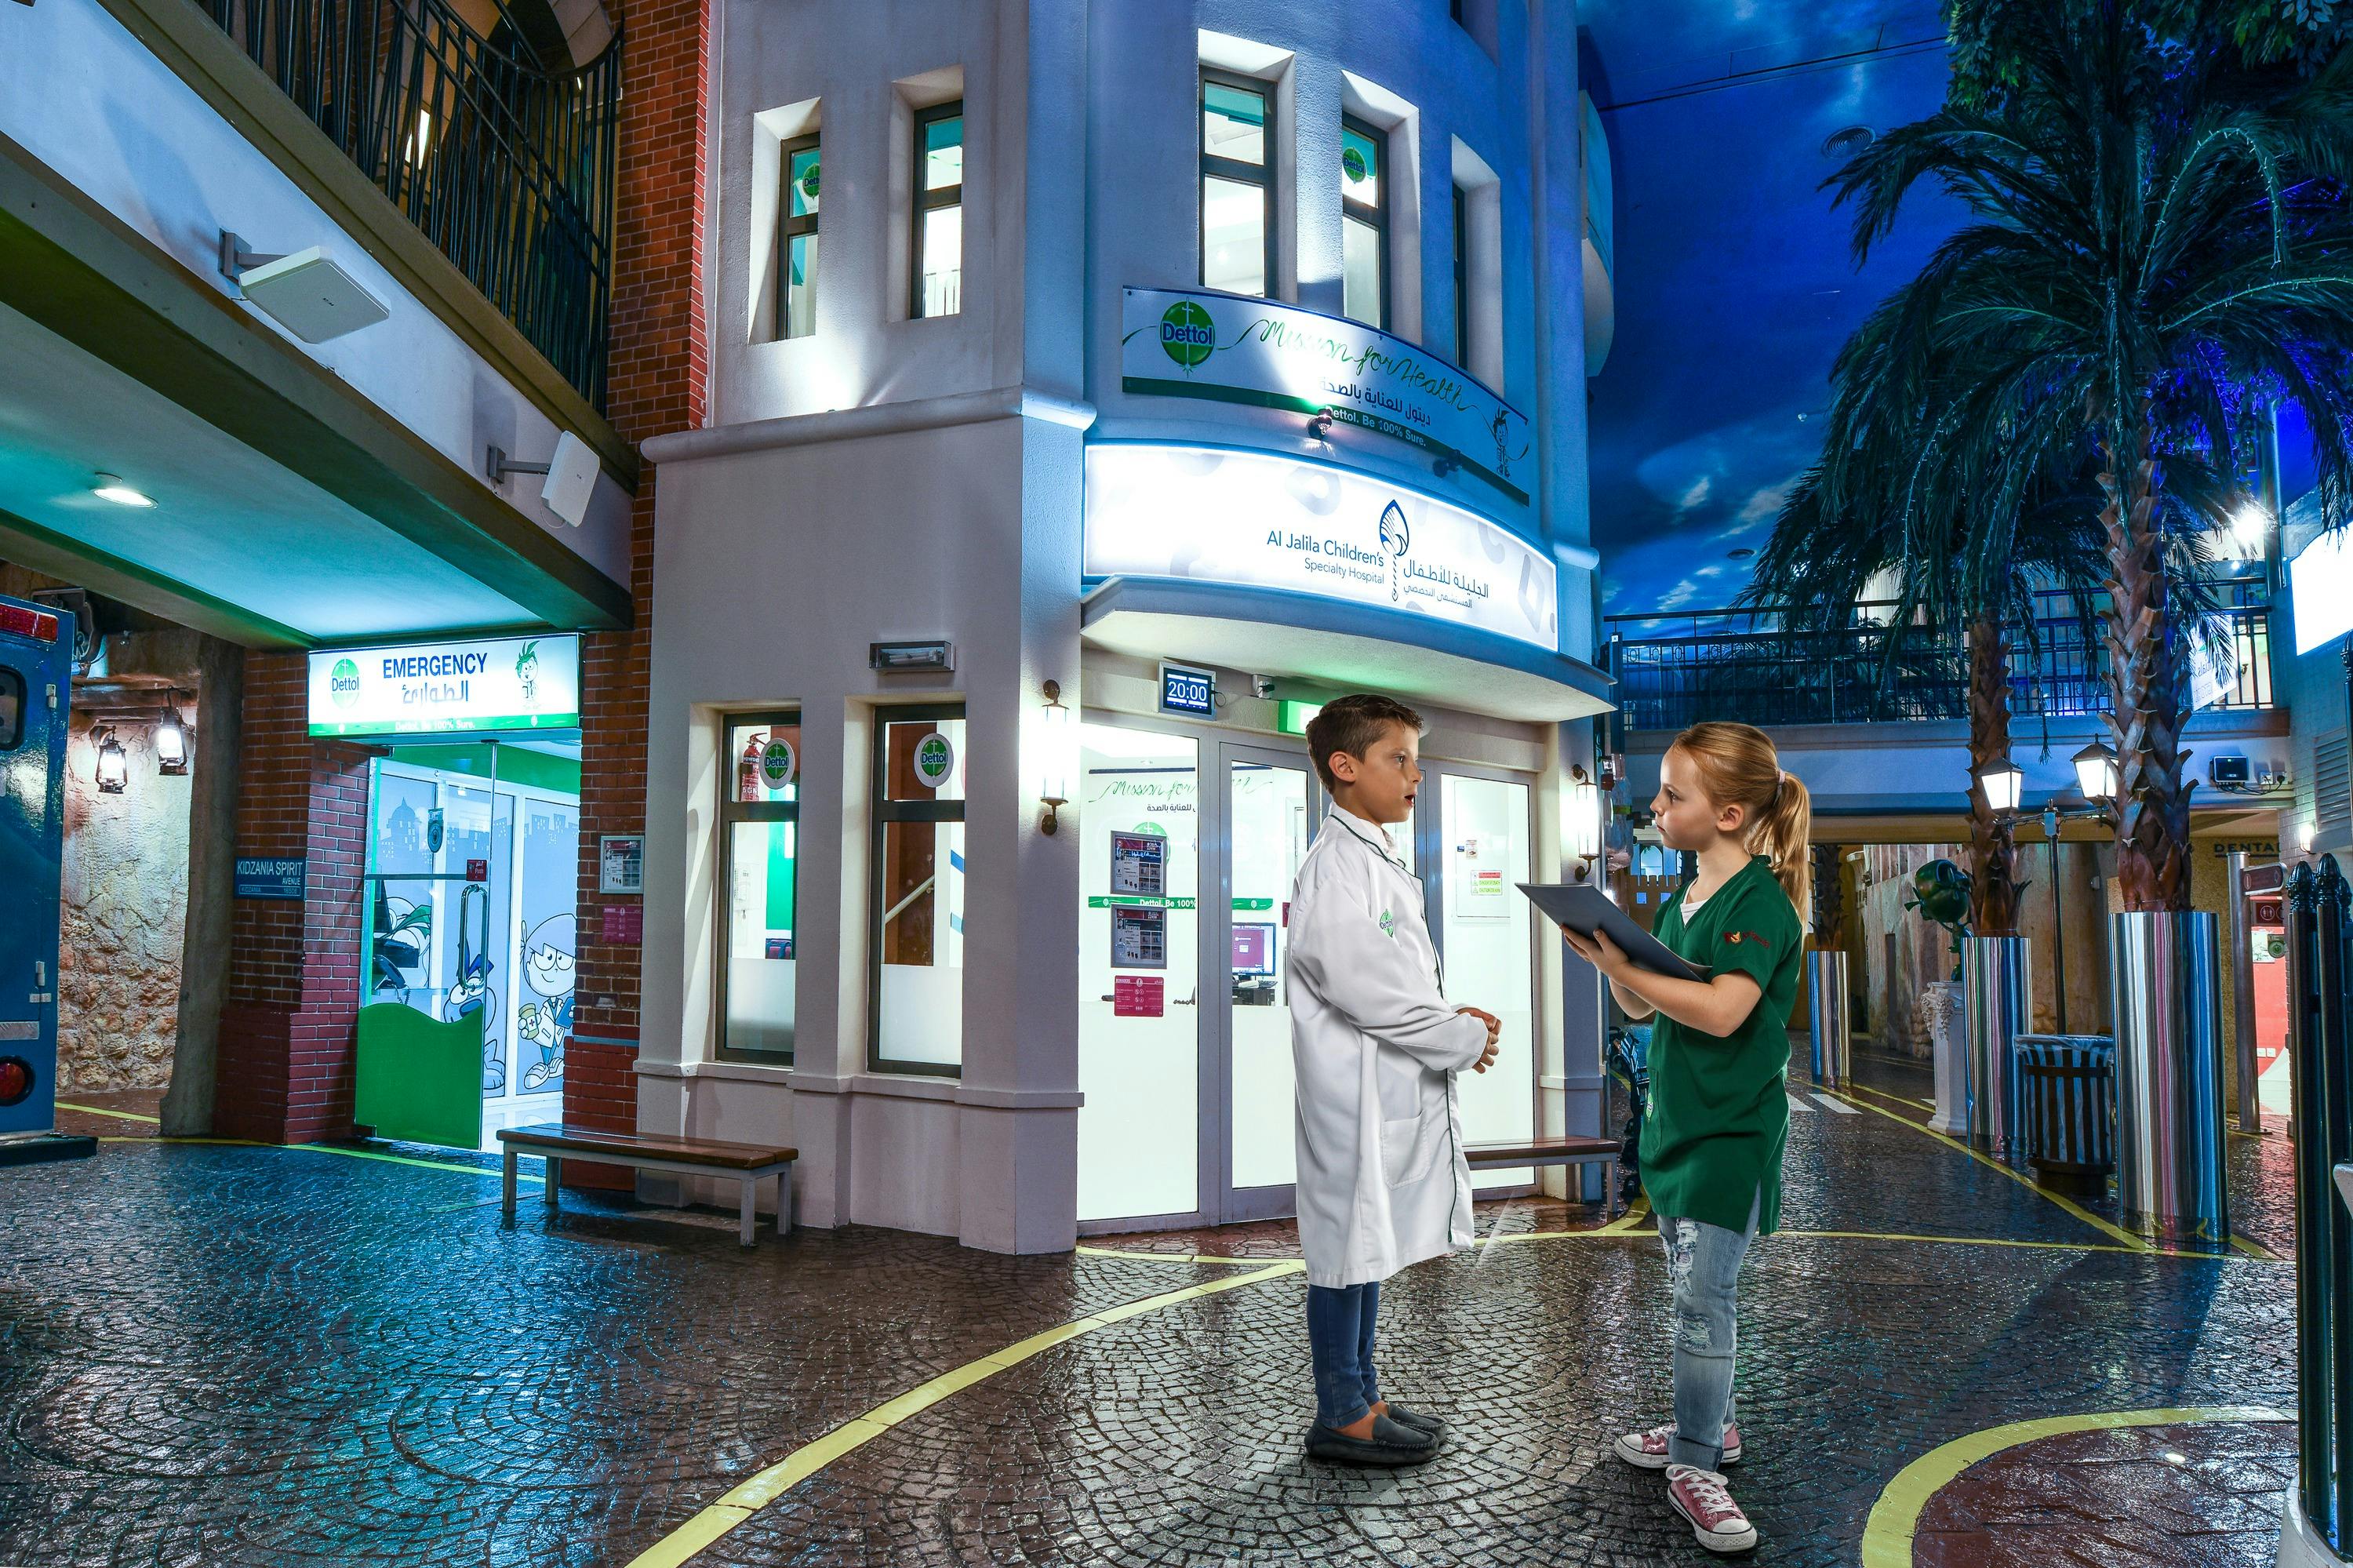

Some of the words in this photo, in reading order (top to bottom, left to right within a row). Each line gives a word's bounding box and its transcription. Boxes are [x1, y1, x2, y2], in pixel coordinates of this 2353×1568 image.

[1162, 322, 1213, 345] Dettol
[1391, 358, 1468, 411] Health
[1365, 387, 1402, 413] للعناية
[1405, 402, 1431, 427] ديتول
[1362, 414, 1375, 427] Be
[1405, 429, 1426, 447] Sure.
[1267, 530, 1282, 547] Al
[1286, 533, 1319, 553] Jalila
[1324, 540, 1384, 567] Children's
[1304, 558, 1347, 580] Specialty
[1349, 568, 1384, 584] Hospital
[1403, 558, 1450, 585] للأطفال
[1453, 572, 1489, 599] الجليلة
[383, 653, 488, 678] EMERGENCY
[332, 676, 359, 691] Dettol
[1168, 681, 1207, 702] 20:00
[765, 756, 788, 767] Dettol
[921, 753, 947, 764] Dettol
[1108, 780, 1166, 798] Mission
[1147, 803, 1169, 813] بالصحة
[1169, 803, 1192, 813] للعناية
[237, 860, 275, 875] KIDZANIA
[275, 861, 303, 876] SPIRIT
[282, 877, 301, 886] AVENUE
